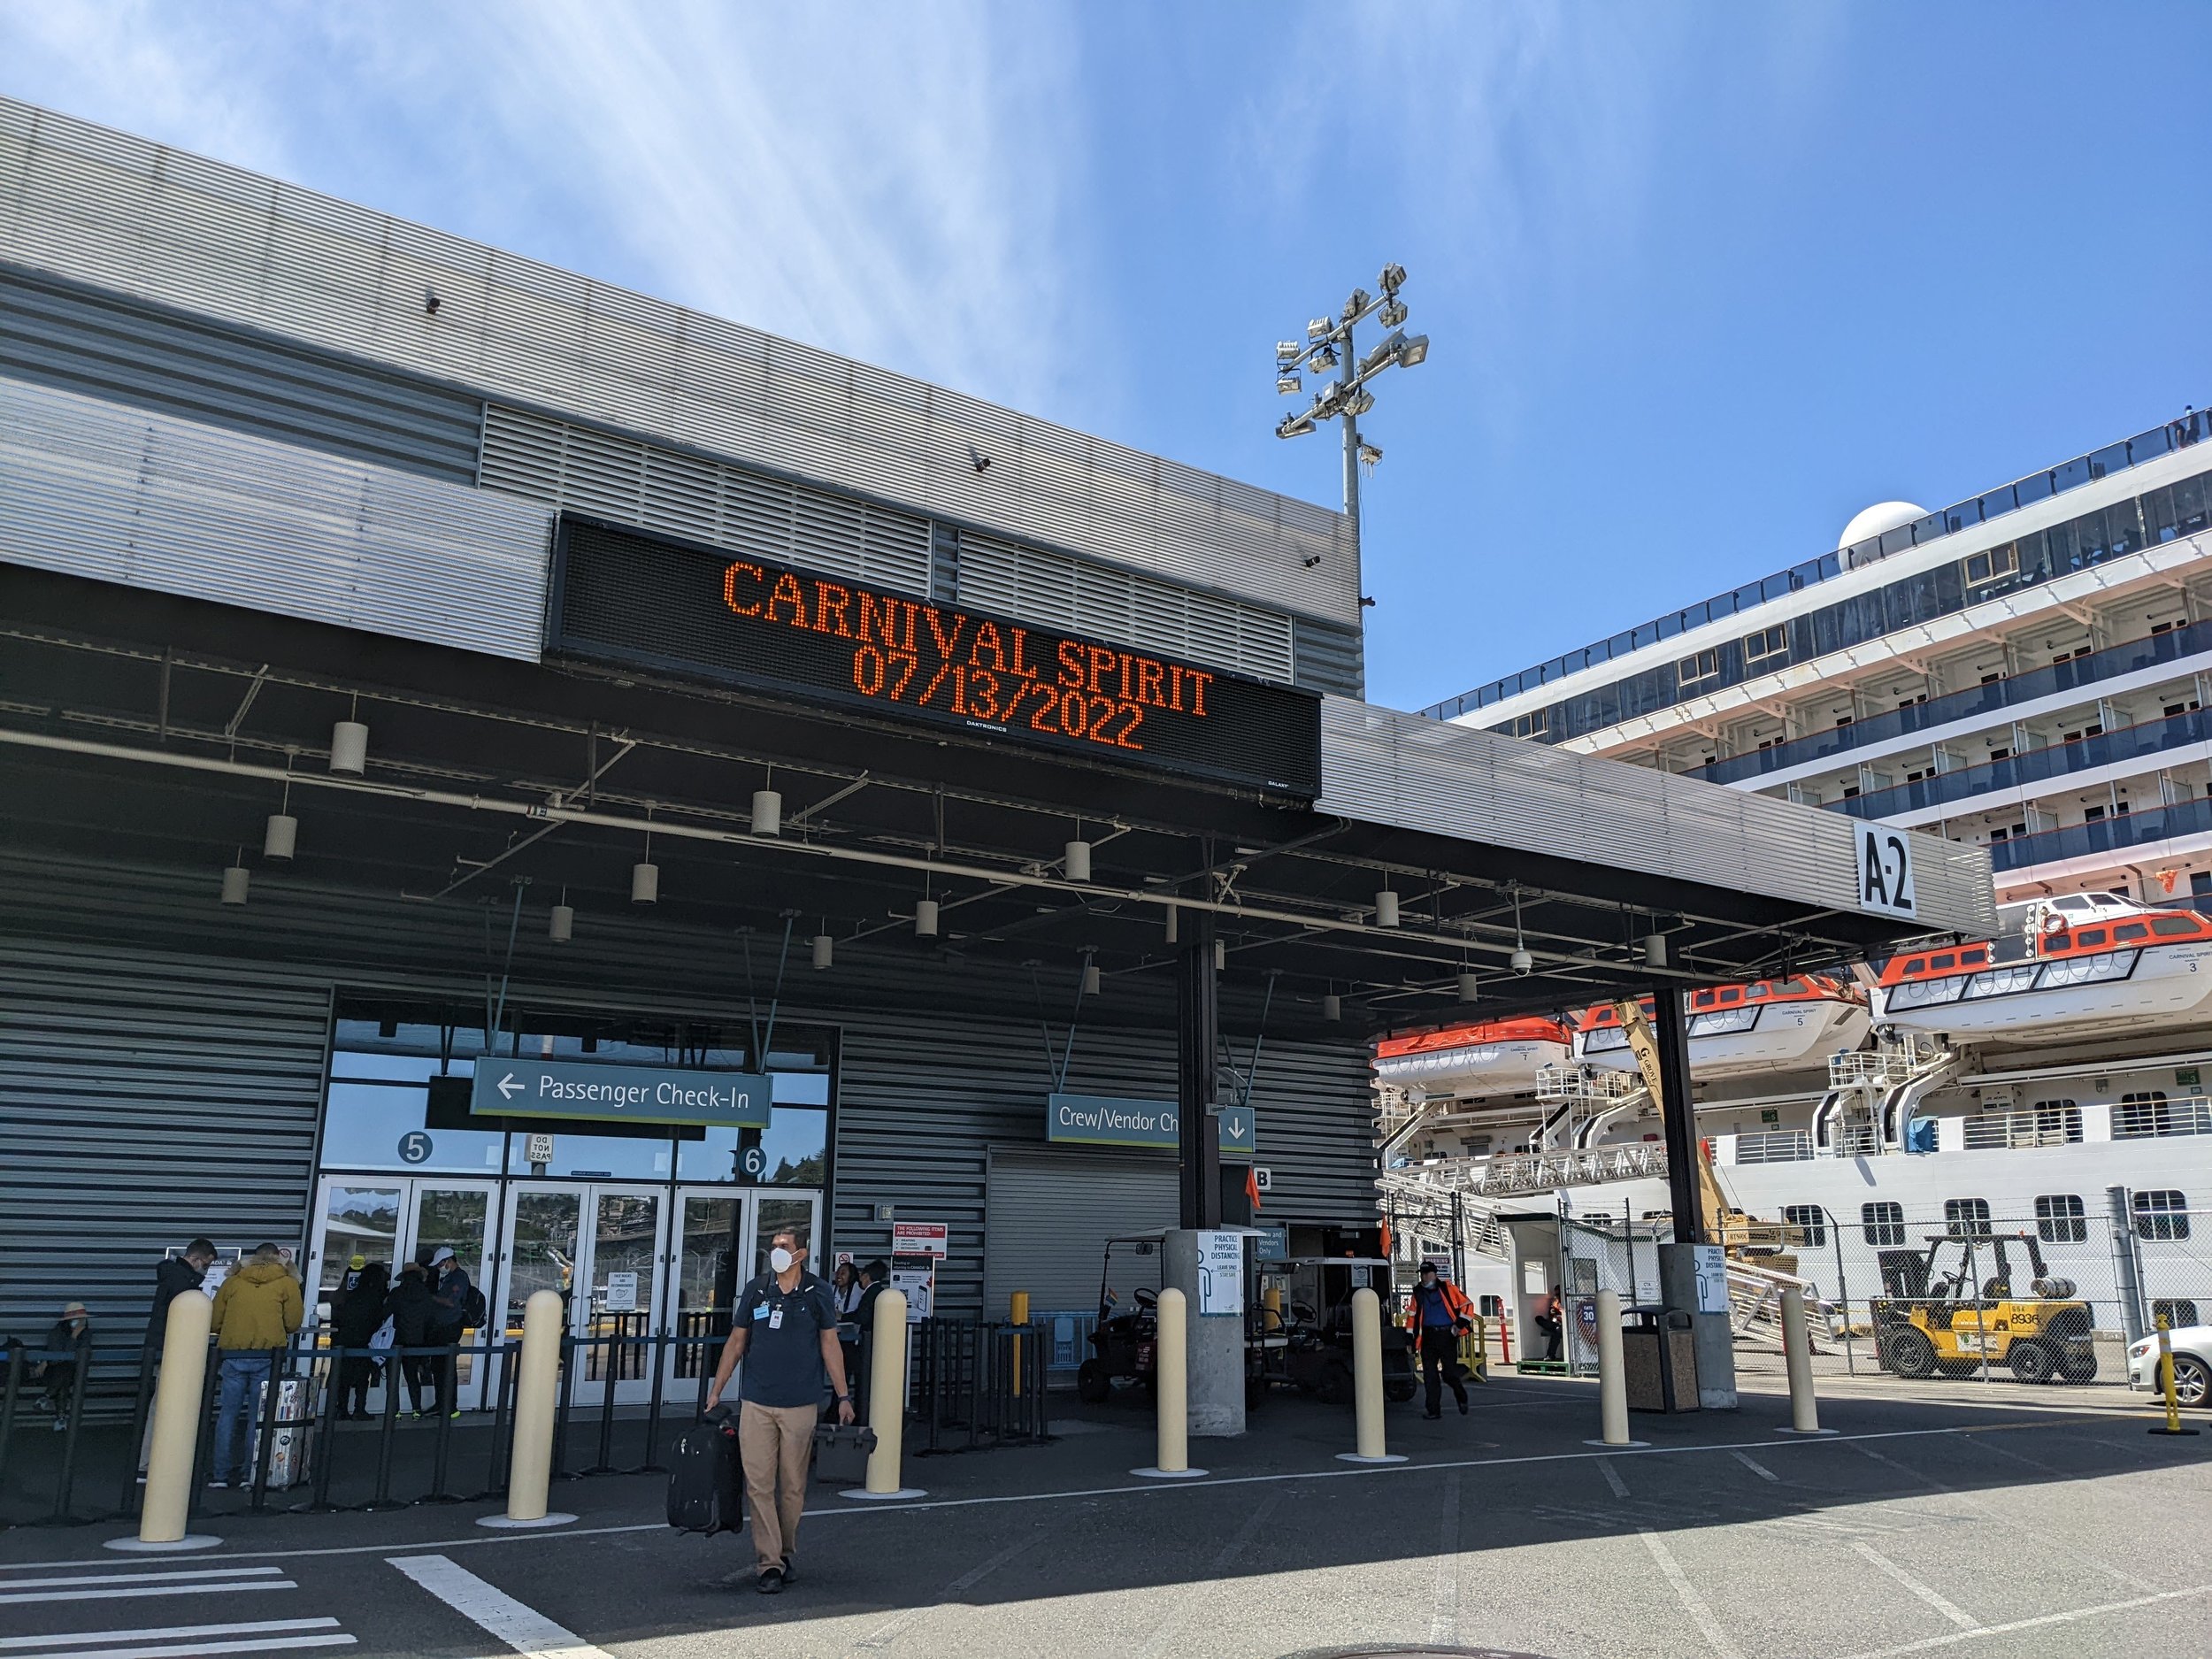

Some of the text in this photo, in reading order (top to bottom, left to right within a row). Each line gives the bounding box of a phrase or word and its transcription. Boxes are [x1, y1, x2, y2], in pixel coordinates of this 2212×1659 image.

[723, 560, 1214, 717] CARNIVAL SPIRIT
[852, 643, 1144, 750] 07/13/2022
[966, 720, 1007, 733] DAKTRONICS
[2189, 963, 2197, 972] 3
[1797, 1018, 1803, 1026] 5
[1644, 1059, 1657, 1082] GROVE
[539, 1075, 749, 1109] Passenger Check-In
[1059, 1106, 1156, 1131] Crew/Vendor
[406, 1134, 425, 1161] 5
[745, 1148, 760, 1173] 6
[1256, 1171, 1268, 1187] B
[1258, 1247, 1271, 1256] Only
[1583, 1311, 1594, 1321] 30
[2011, 1313, 2040, 1325] 8936
